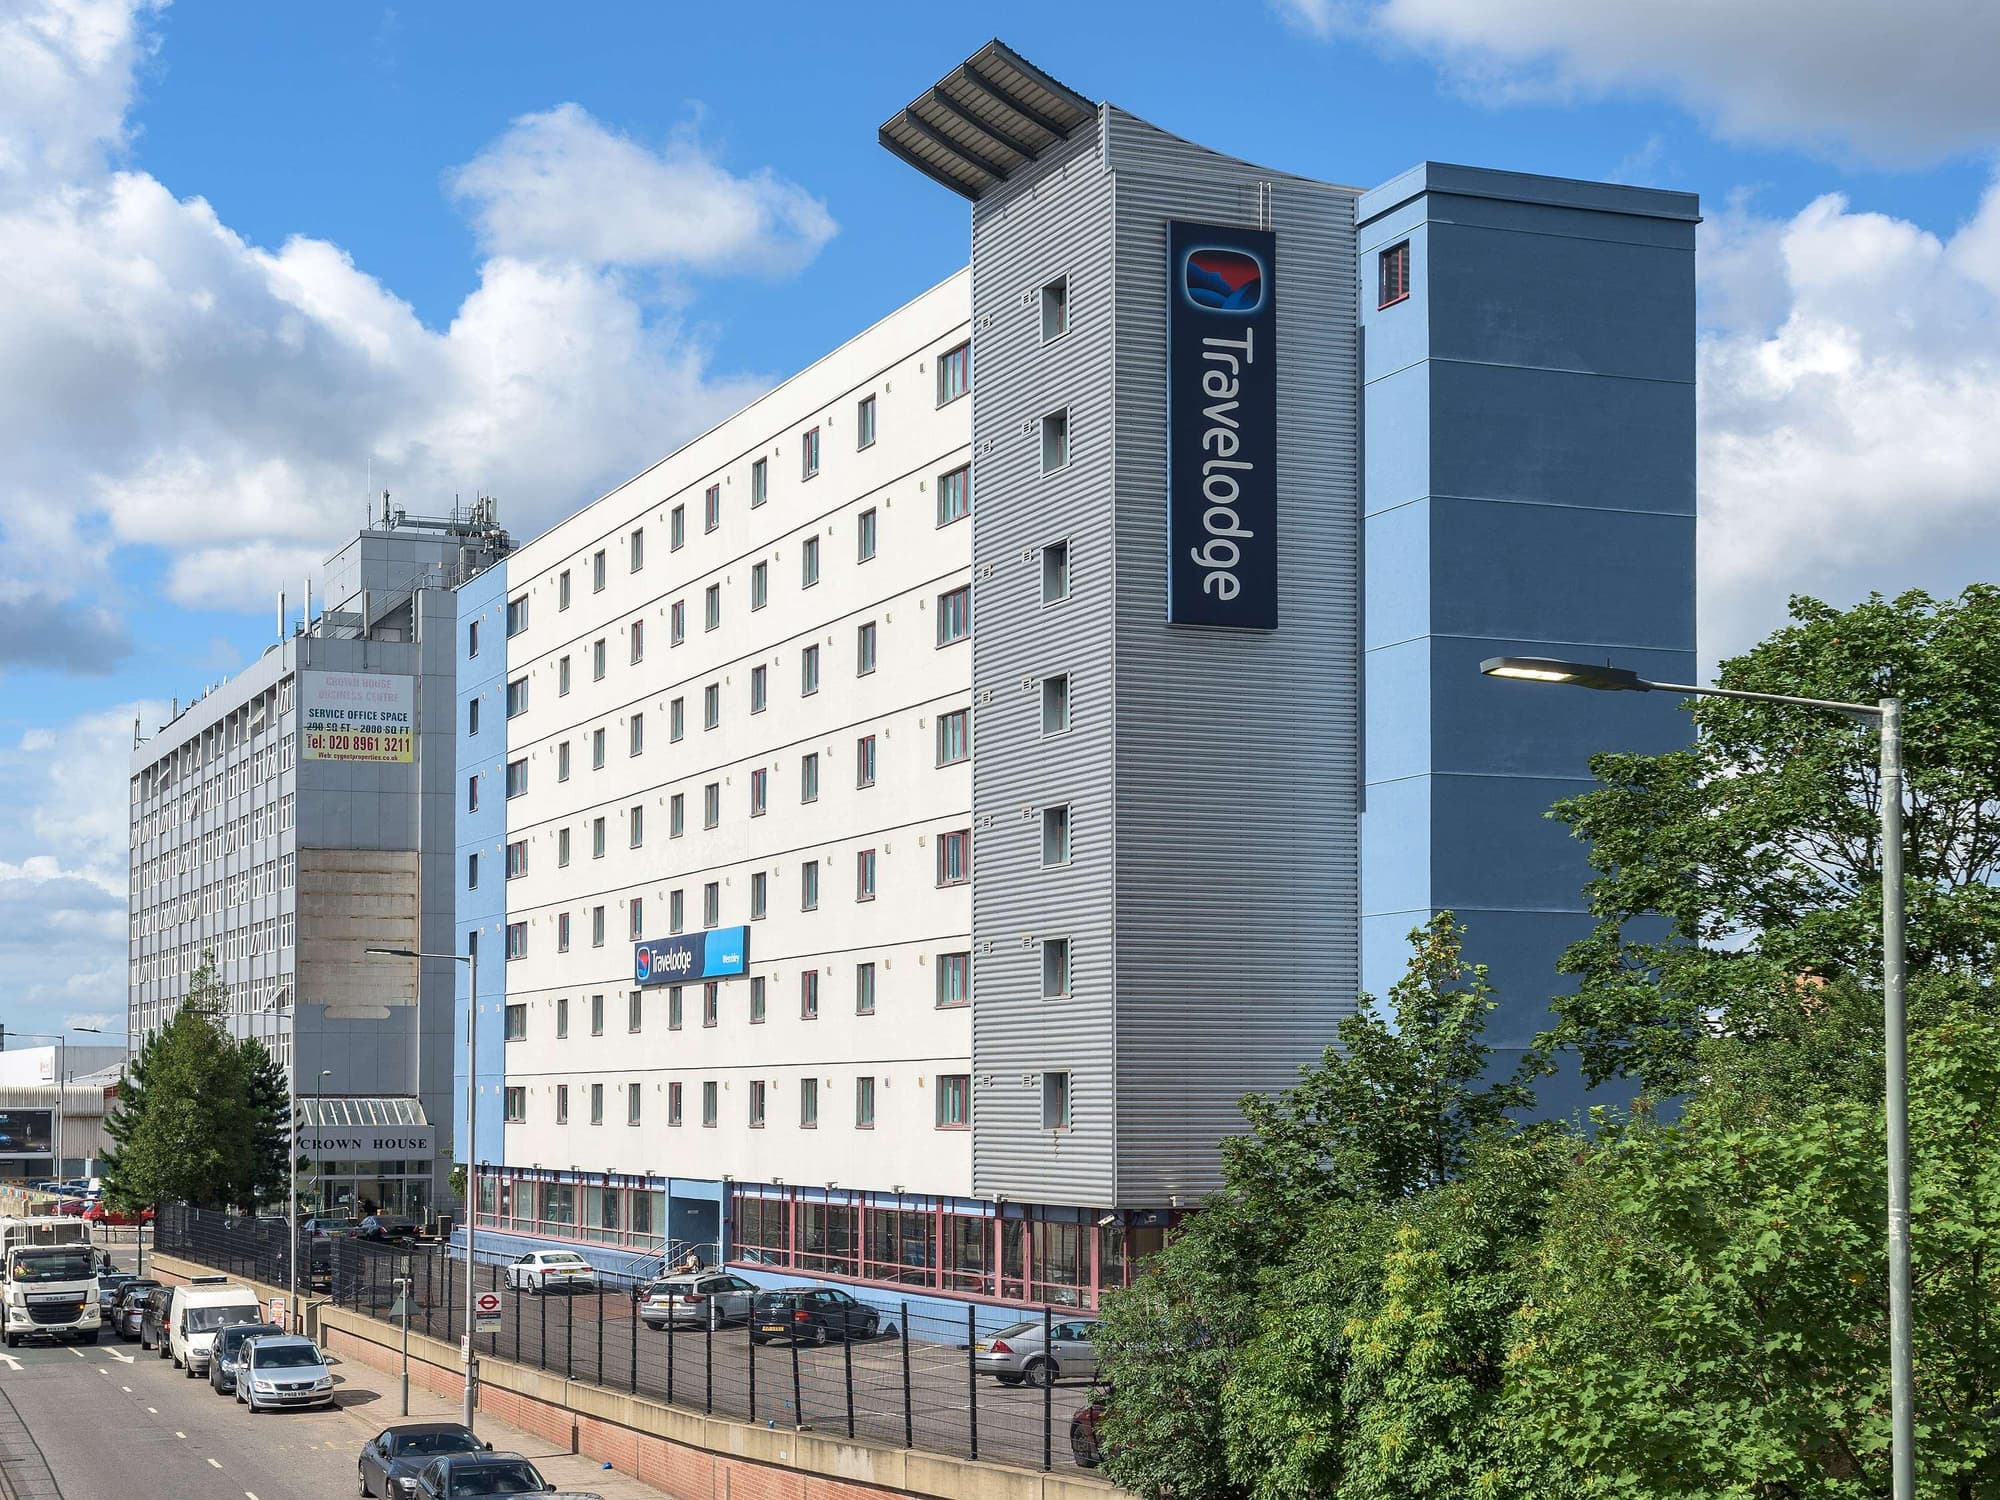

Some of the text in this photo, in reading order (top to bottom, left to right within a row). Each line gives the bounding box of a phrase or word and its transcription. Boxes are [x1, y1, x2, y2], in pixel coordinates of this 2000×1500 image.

[1190, 327, 1254, 601] Travelodge
[362, 678, 392, 689] HOUSE
[309, 708, 408, 722] SERVICE OFFICE SPACE
[325, 722, 338, 732] SQ
[340, 723, 351, 733] FT
[360, 724, 382, 734] 2000
[385, 725, 397, 735] SQ
[399, 726, 410, 735] FT
[306, 733, 410, 753] Tel: 020 8961 3211
[651, 945, 692, 975] Travelodge
[300, 1138, 427, 1150] CROWN HOUSE
